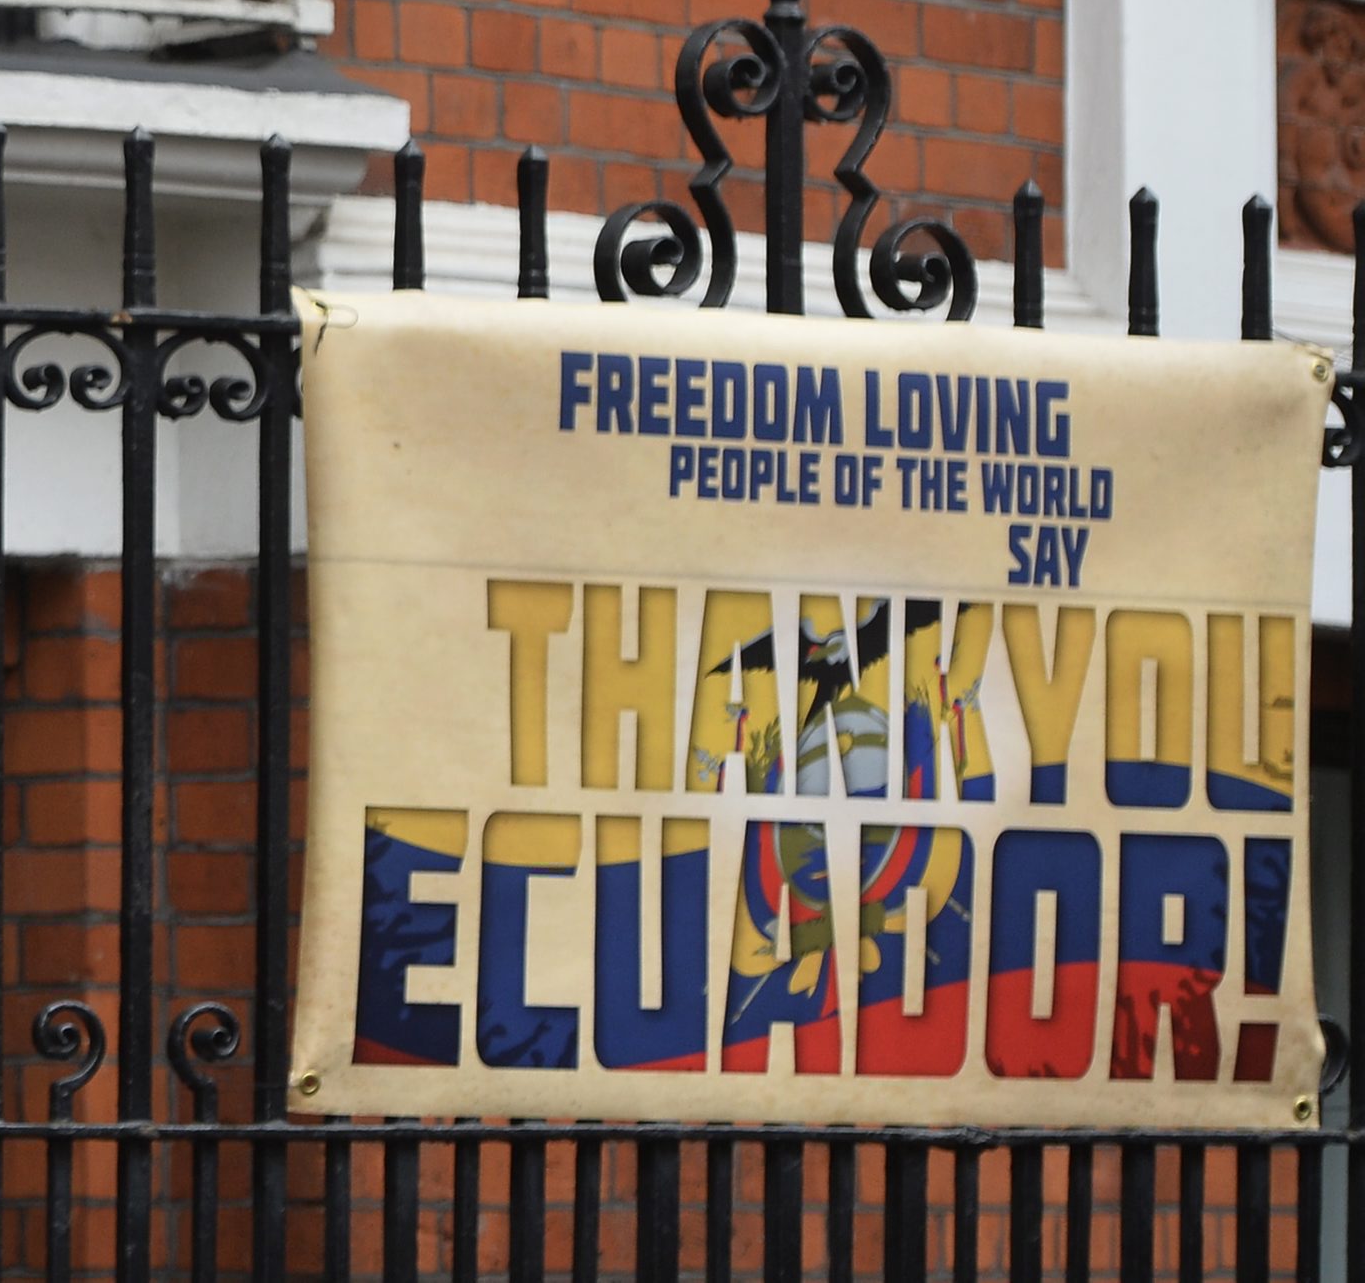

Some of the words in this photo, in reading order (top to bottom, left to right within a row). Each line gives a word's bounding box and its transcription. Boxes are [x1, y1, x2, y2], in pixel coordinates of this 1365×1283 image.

[559, 351, 844, 445] FREEDOM
[864, 369, 1070, 457] LOVING
[669, 445, 821, 505] PEOPLE
[834, 453, 884, 507] OF
[897, 457, 969, 512] THE
[982, 461, 1113, 520] WORLD
[1008, 524, 1089, 588] SAY
[350, 805, 1294, 1084] ECUADOR!
